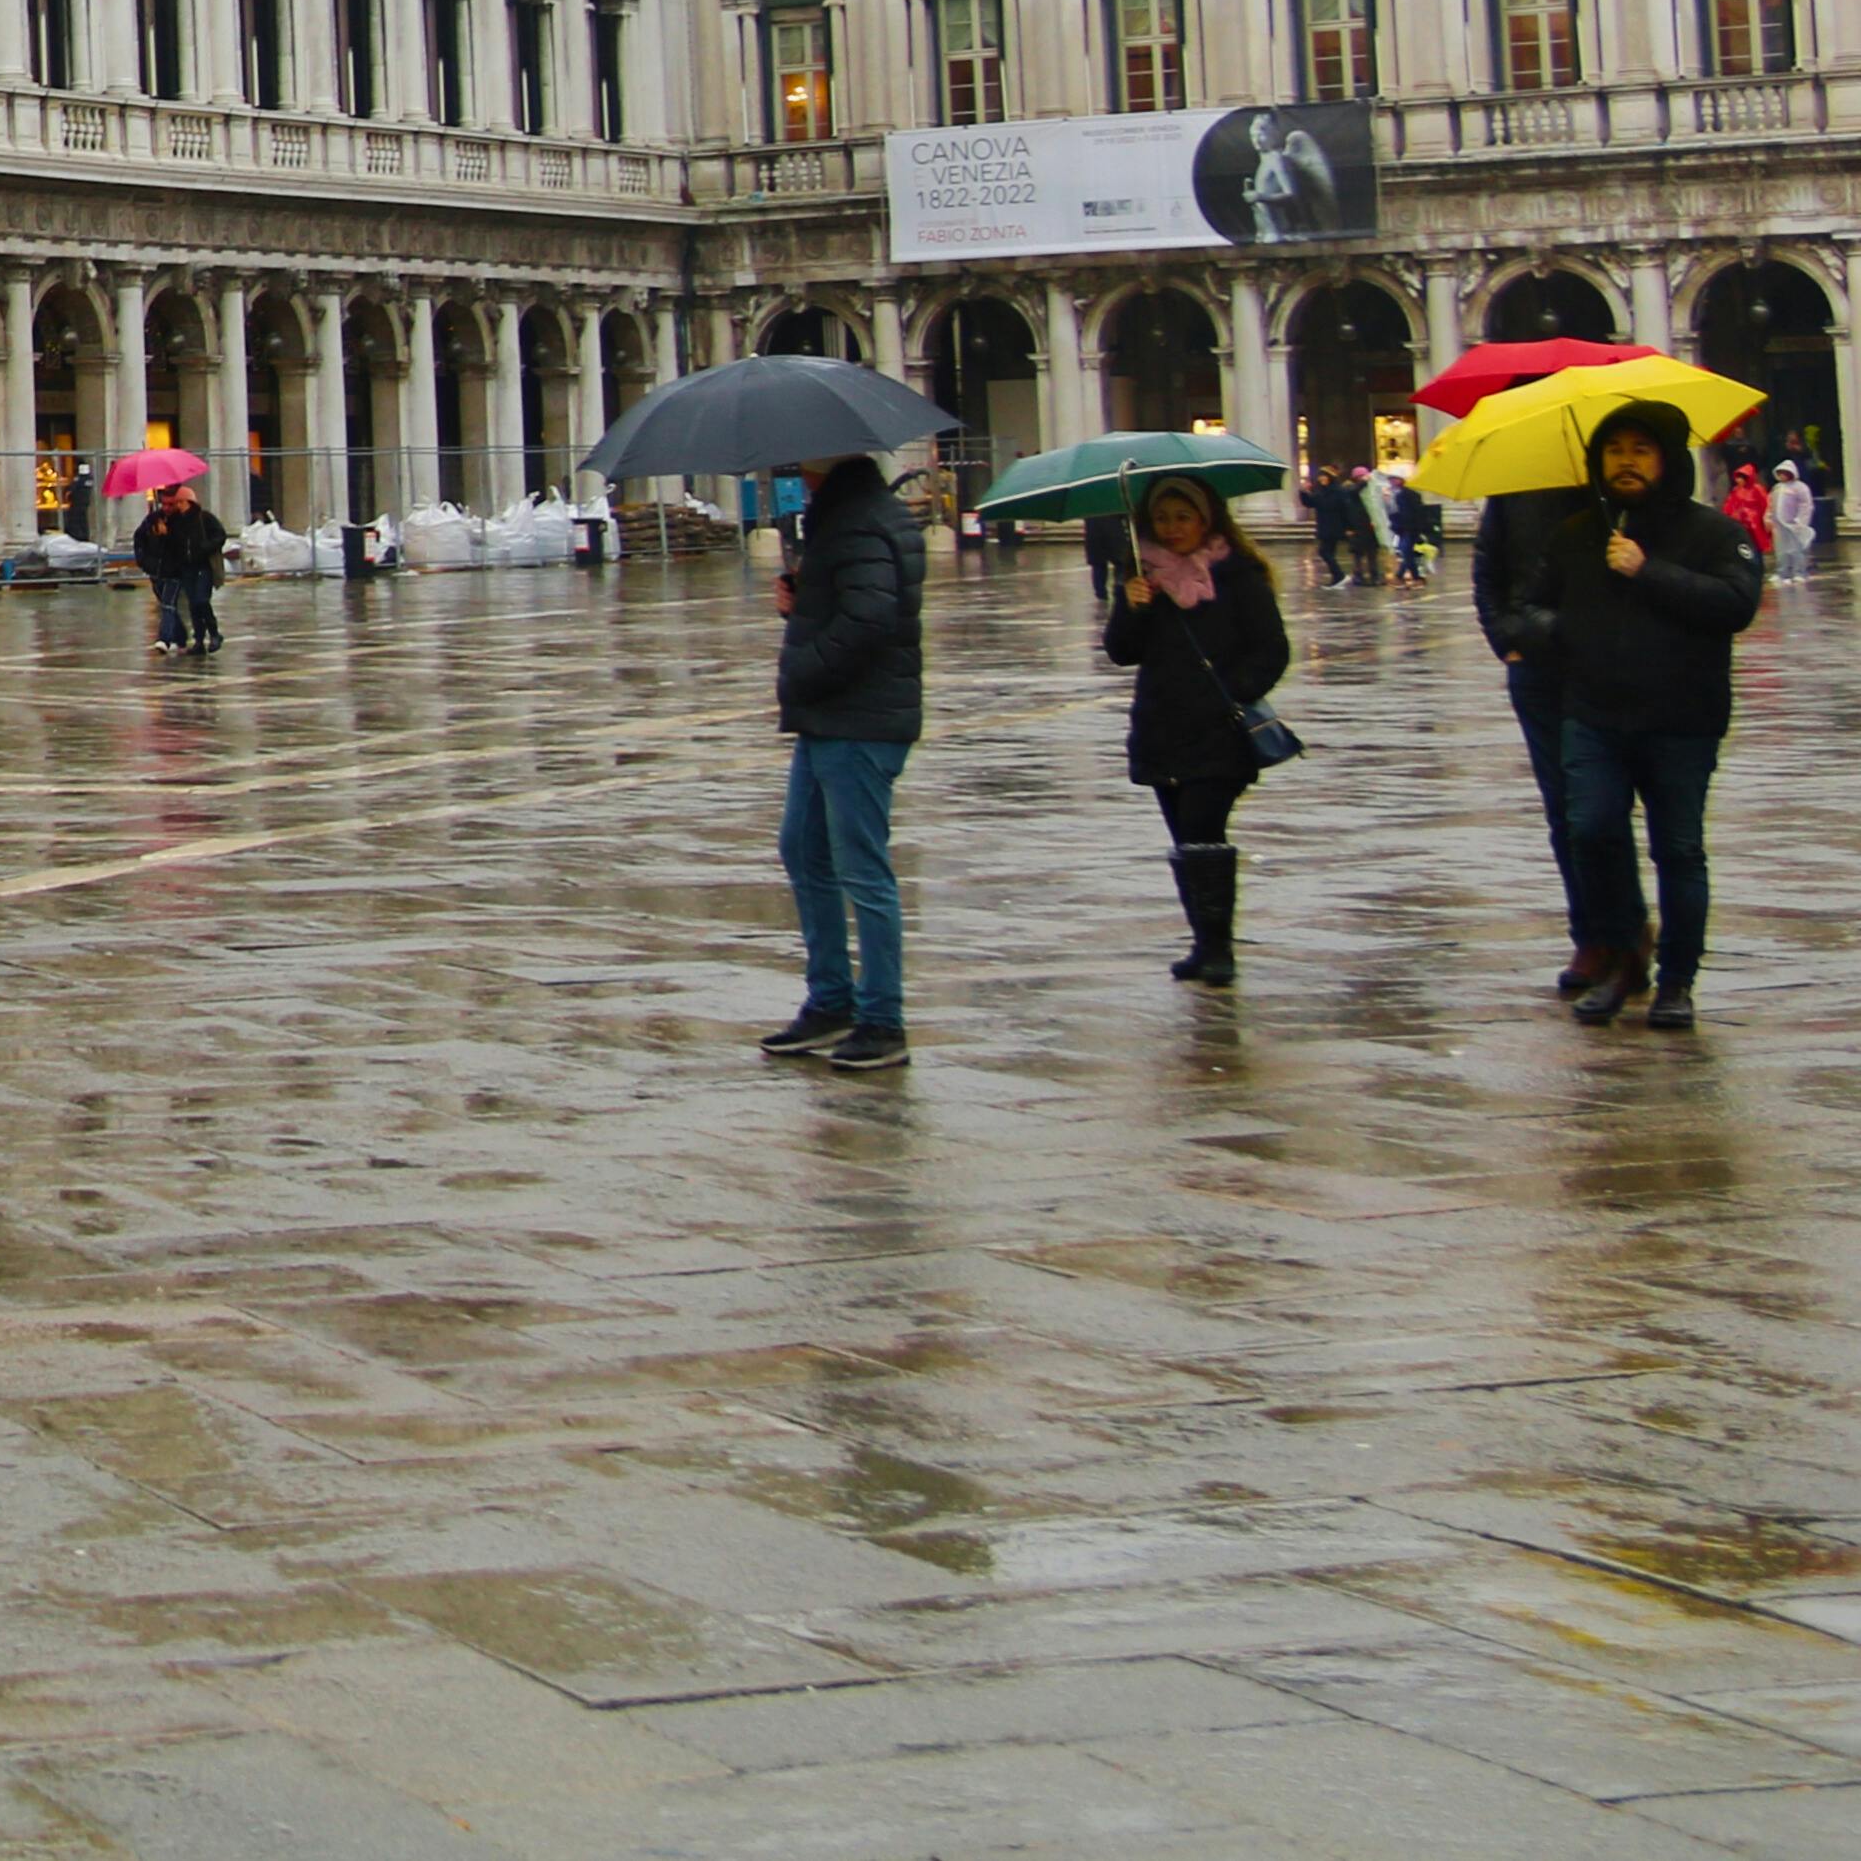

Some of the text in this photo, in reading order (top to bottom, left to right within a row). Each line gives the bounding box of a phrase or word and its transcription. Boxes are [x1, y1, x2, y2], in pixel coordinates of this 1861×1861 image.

[911, 136, 1030, 165] CANOVA
[931, 161, 1033, 185] VENEZIA
[917, 183, 1036, 209] 1822-2022
[917, 224, 1028, 244] FABIO ZONTA
